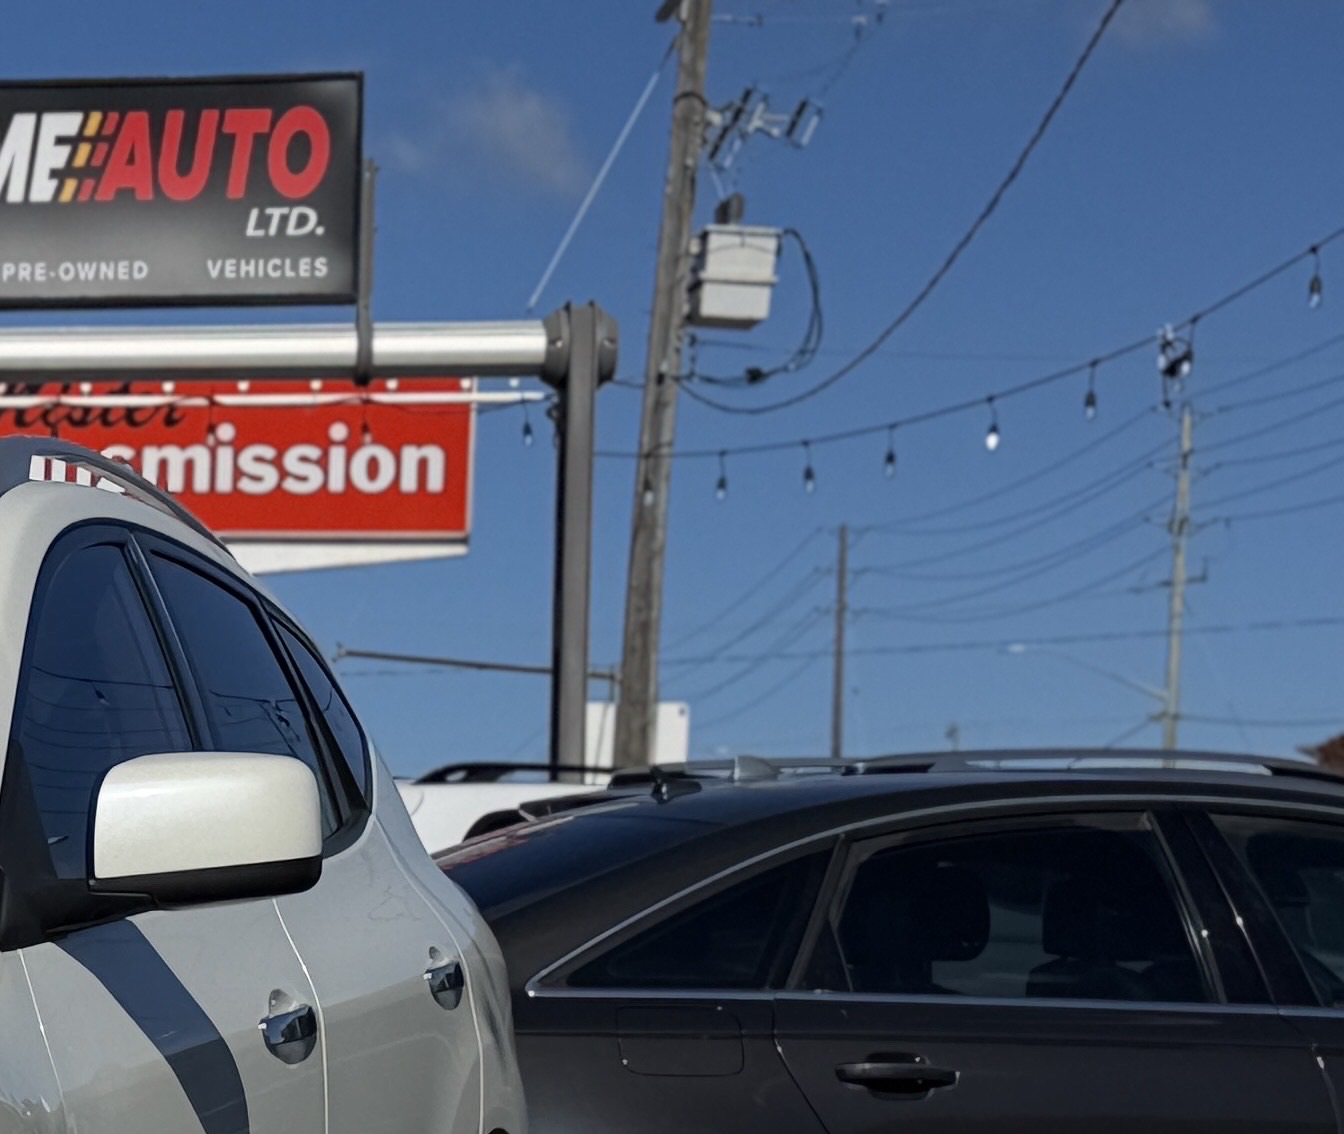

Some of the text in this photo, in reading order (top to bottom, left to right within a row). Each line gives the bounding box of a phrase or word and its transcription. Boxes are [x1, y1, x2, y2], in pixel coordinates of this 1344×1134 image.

[96, 105, 330, 201] AUTO
[245, 207, 326, 237] LTD.
[1, 260, 150, 283] PRE-OWNED
[207, 257, 329, 280] VEHICLES
